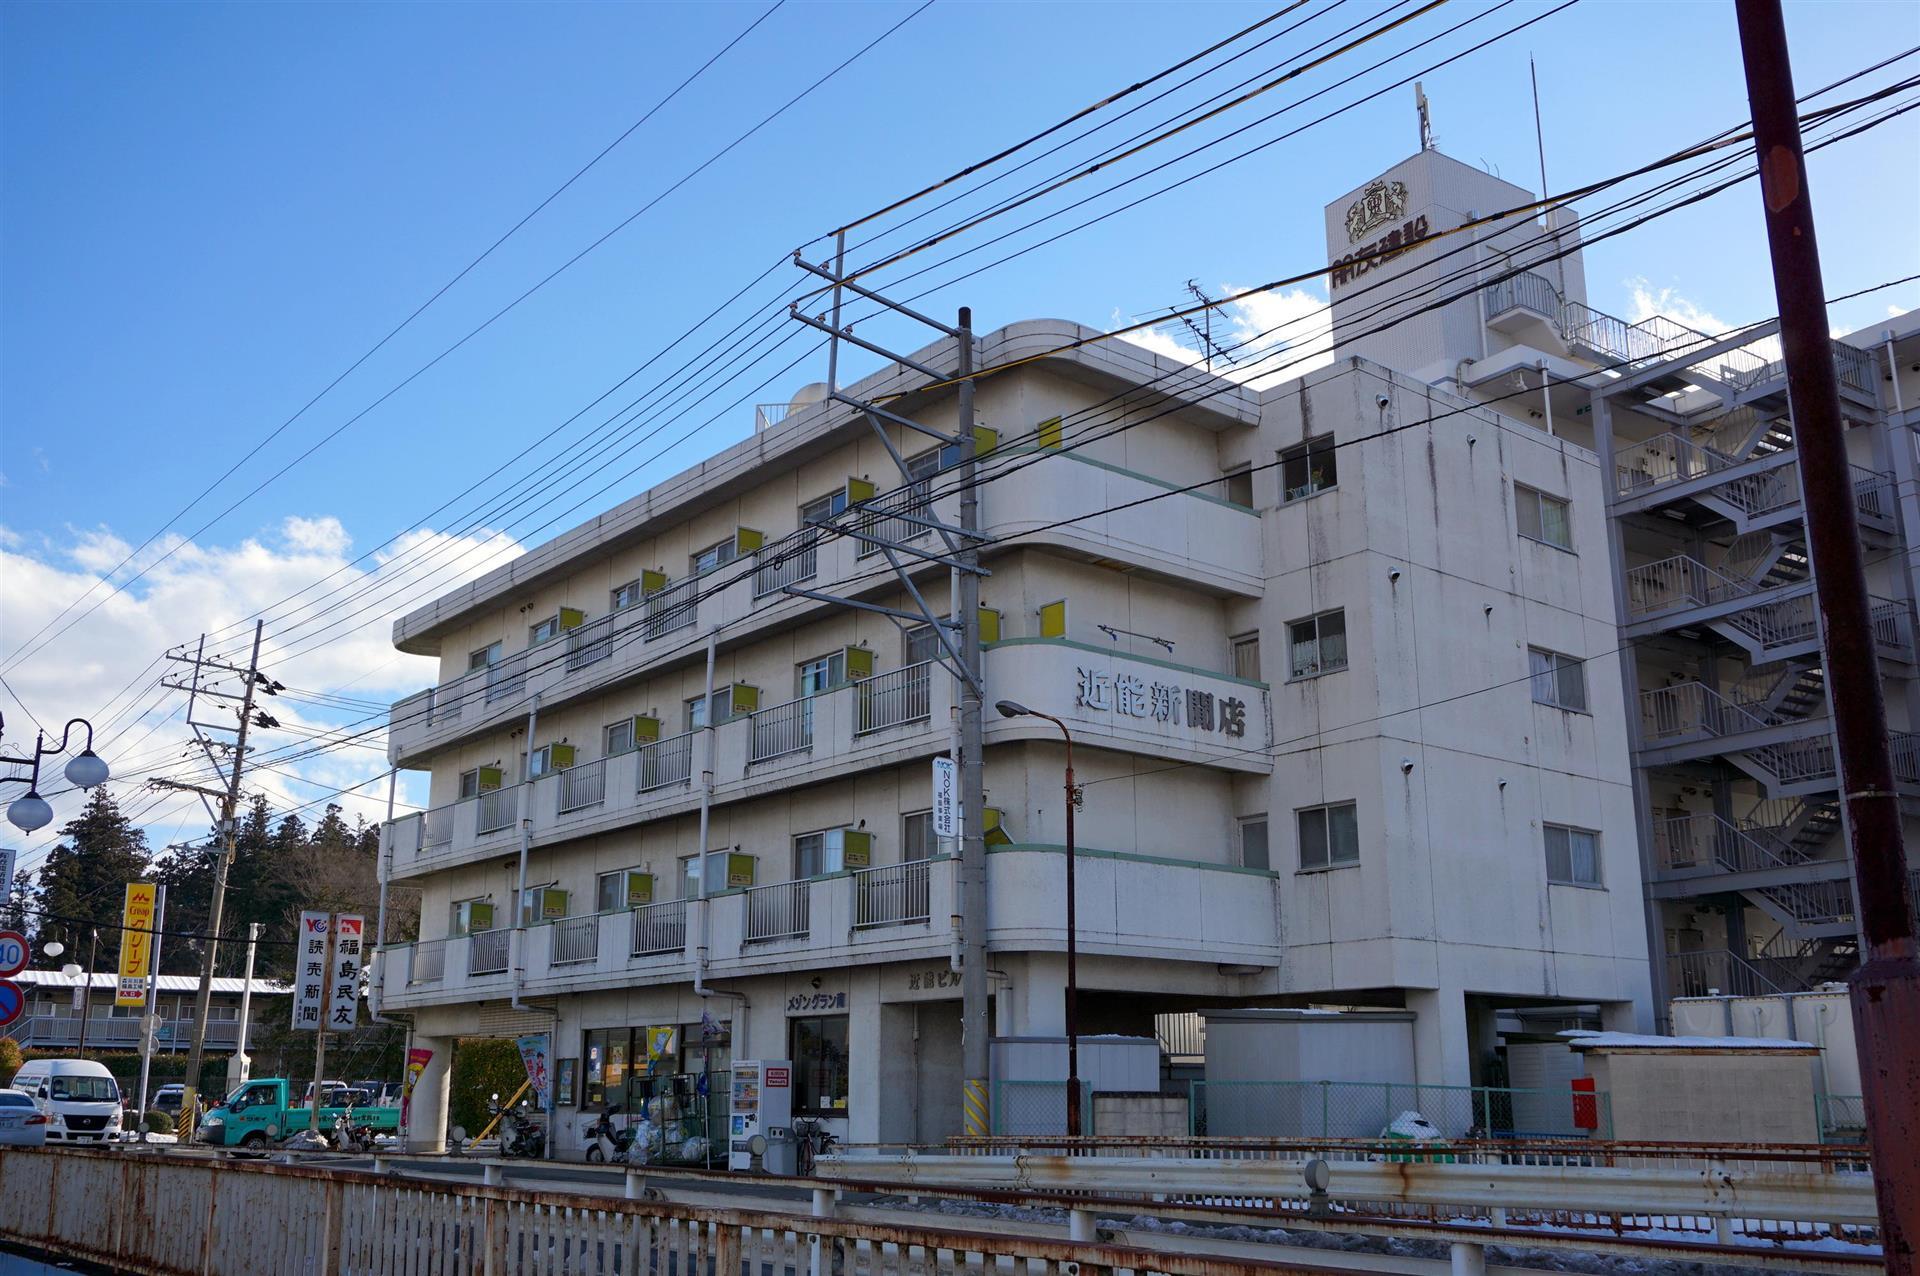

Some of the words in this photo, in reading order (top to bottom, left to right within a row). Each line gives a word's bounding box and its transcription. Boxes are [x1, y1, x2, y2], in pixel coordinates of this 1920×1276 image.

[1076, 666, 1246, 738] 近能新聞店
[302, 939, 324, 1022] 読売新聞
[333, 939, 359, 1025] 福島民友
